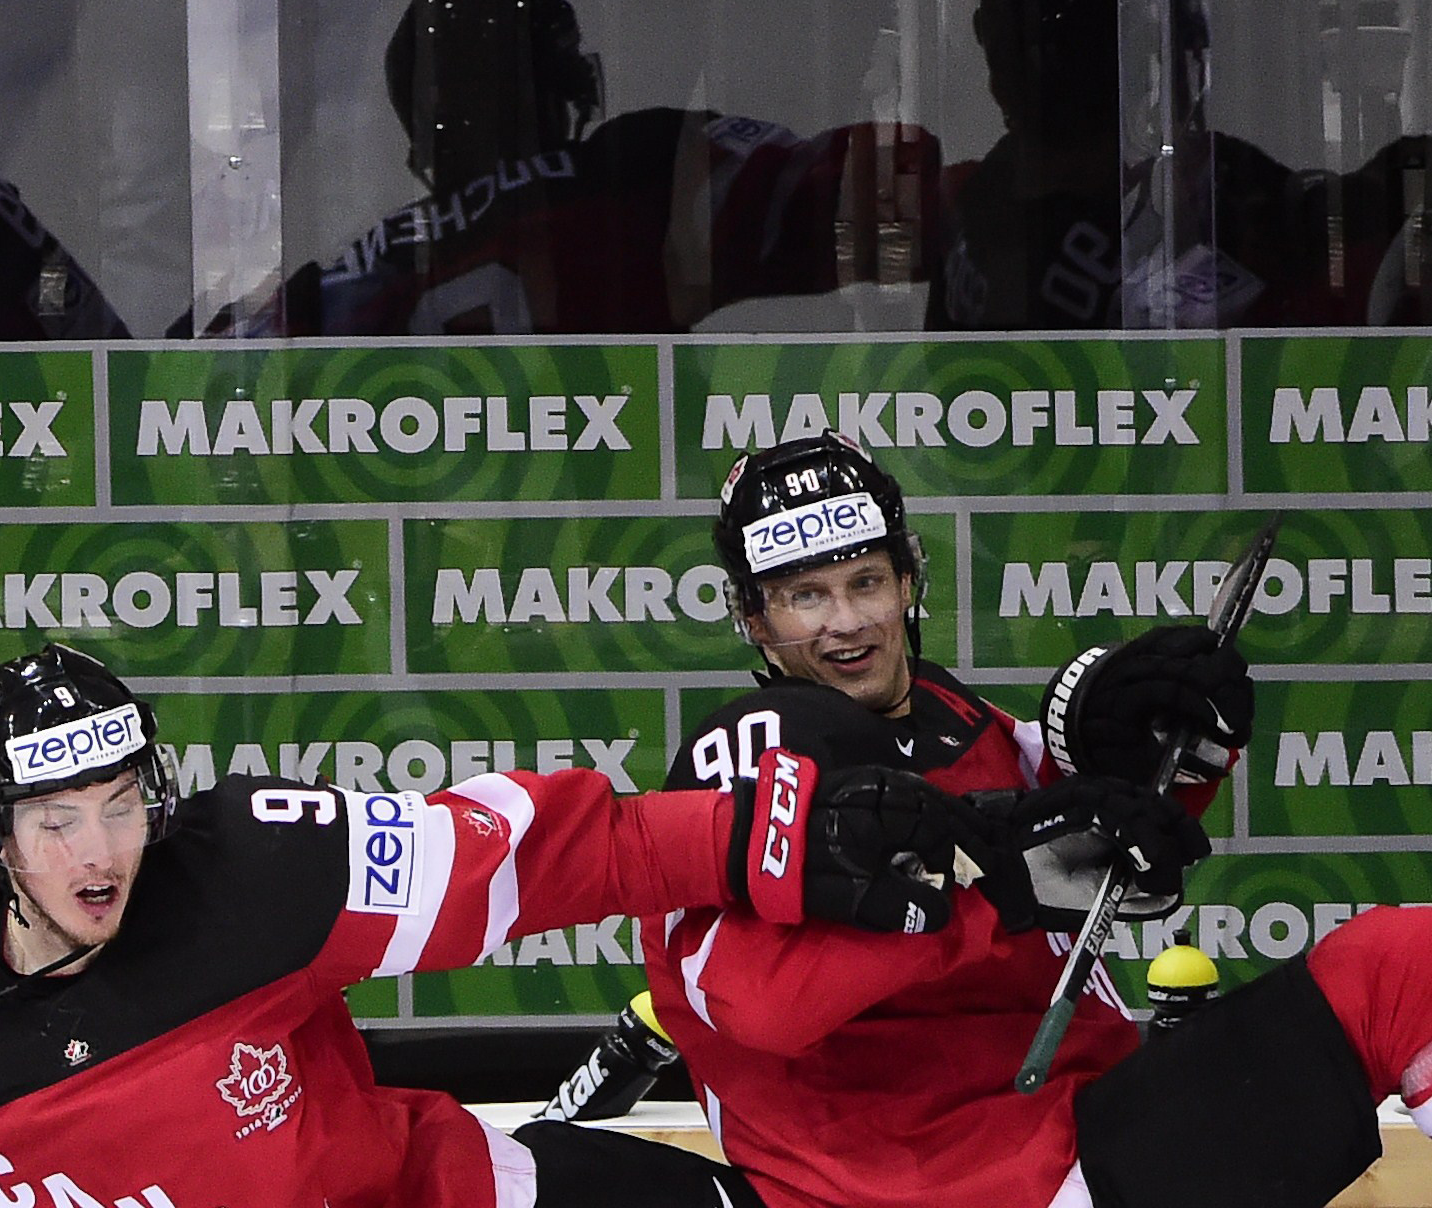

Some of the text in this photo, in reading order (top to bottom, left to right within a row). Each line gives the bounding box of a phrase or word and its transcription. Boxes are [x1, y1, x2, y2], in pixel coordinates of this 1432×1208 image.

[134, 394, 633, 457] MAKROFLEX
[701, 387, 1202, 450] MAKROFLEX
[784, 468, 821, 497] 90
[750, 501, 869, 554] zepter
[53, 686, 76, 708] 9
[13, 712, 135, 769] zepter
[691, 709, 781, 793] 90
[250, 788, 337, 826] 9
[760, 752, 802, 880] CCM
[1085, 896, 1118, 954] EASTON
[239, 1063, 277, 1100] 100
